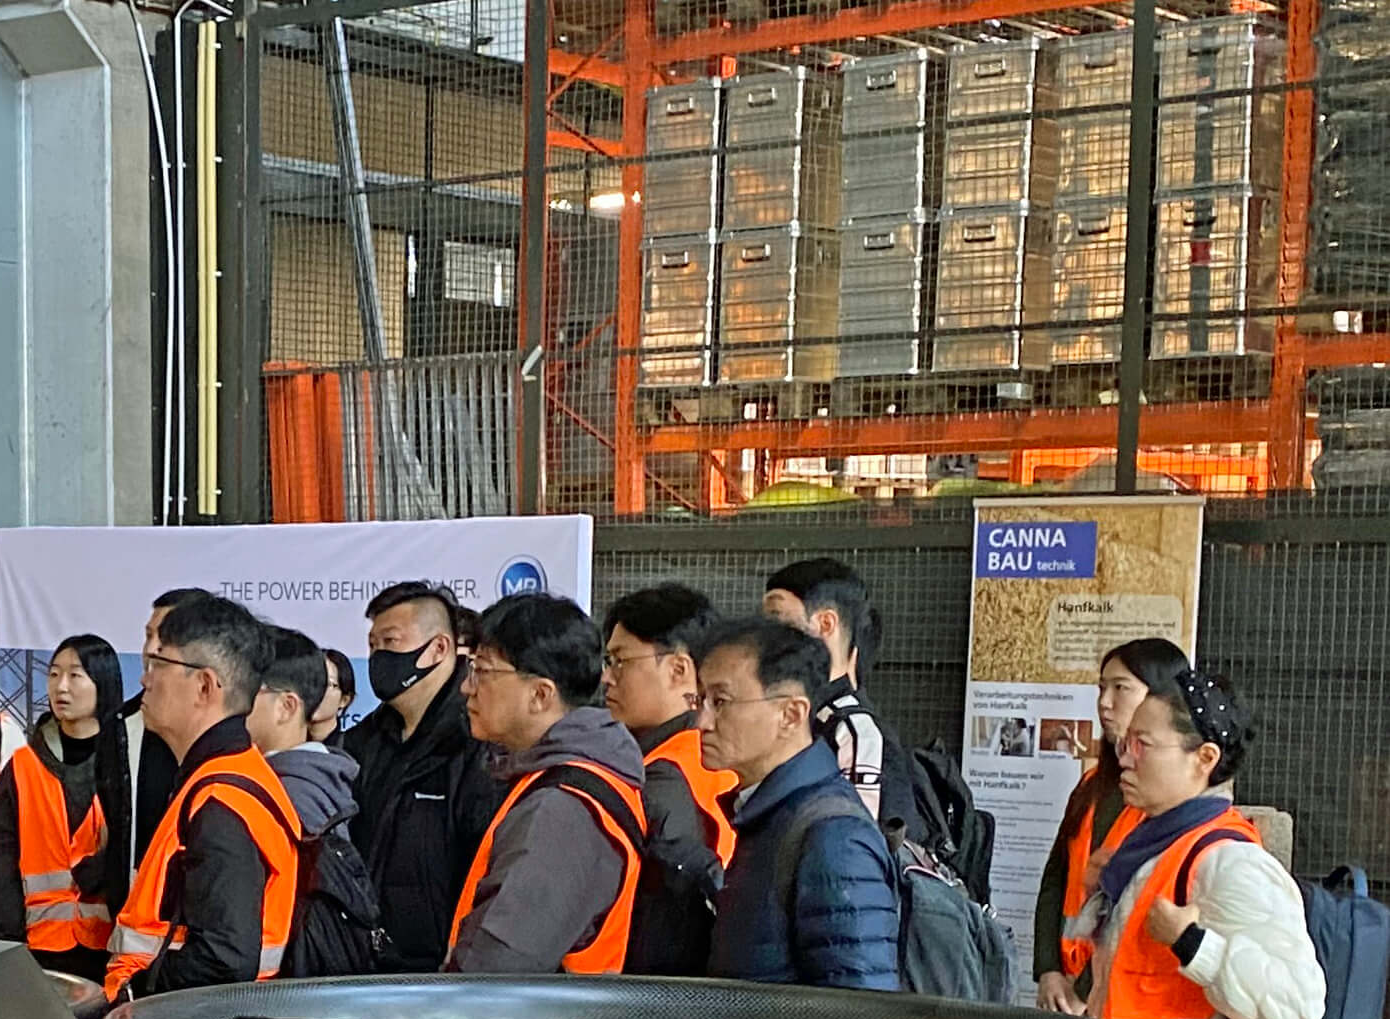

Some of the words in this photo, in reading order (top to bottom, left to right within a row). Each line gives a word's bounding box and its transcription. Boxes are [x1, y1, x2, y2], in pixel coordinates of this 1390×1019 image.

[988, 528, 1067, 548] CANNA
[987, 551, 1033, 571] BAU
[1036, 559, 1076, 571] technik
[220, 581, 253, 601] THE
[259, 581, 323, 601] POWER
[1057, 601, 1114, 615] Hanfkalk
